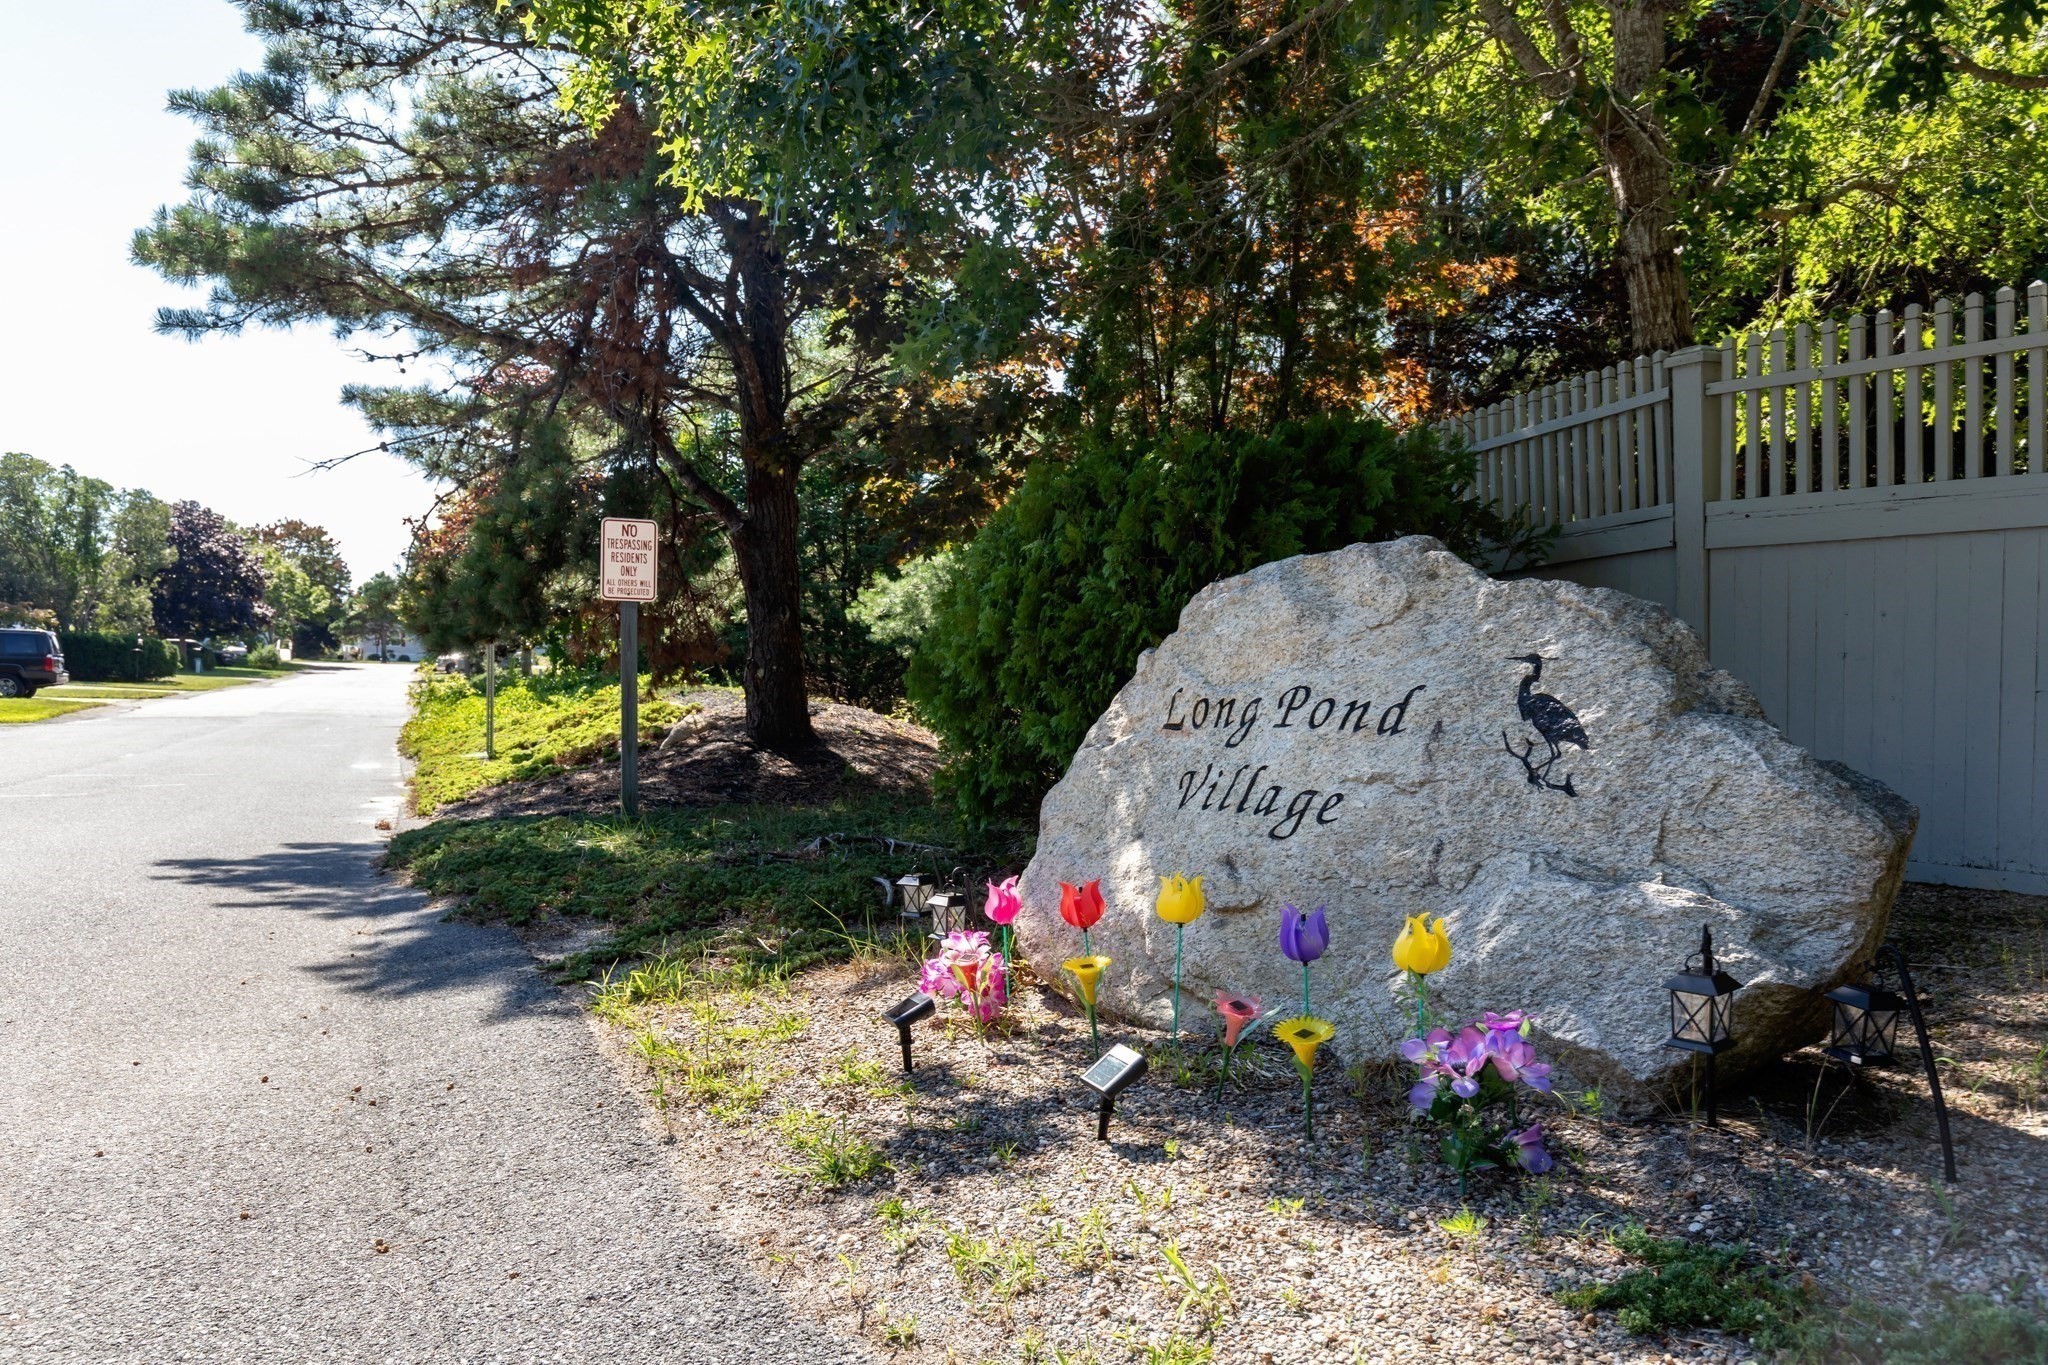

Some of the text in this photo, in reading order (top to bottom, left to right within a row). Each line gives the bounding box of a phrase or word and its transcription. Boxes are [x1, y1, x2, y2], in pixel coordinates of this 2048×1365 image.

[621, 524, 638, 537] NO
[607, 538, 653, 551] TRESPASSING
[610, 552, 648, 564] RESIDENTS
[620, 565, 638, 577] ONLY
[617, 579, 638, 587] OTHERS
[640, 580, 652, 588] WILL
[607, 587, 650, 596] BE PROSECUTED
[1162, 684, 1427, 749] Long Pond
[1177, 762, 1345, 841] Village
